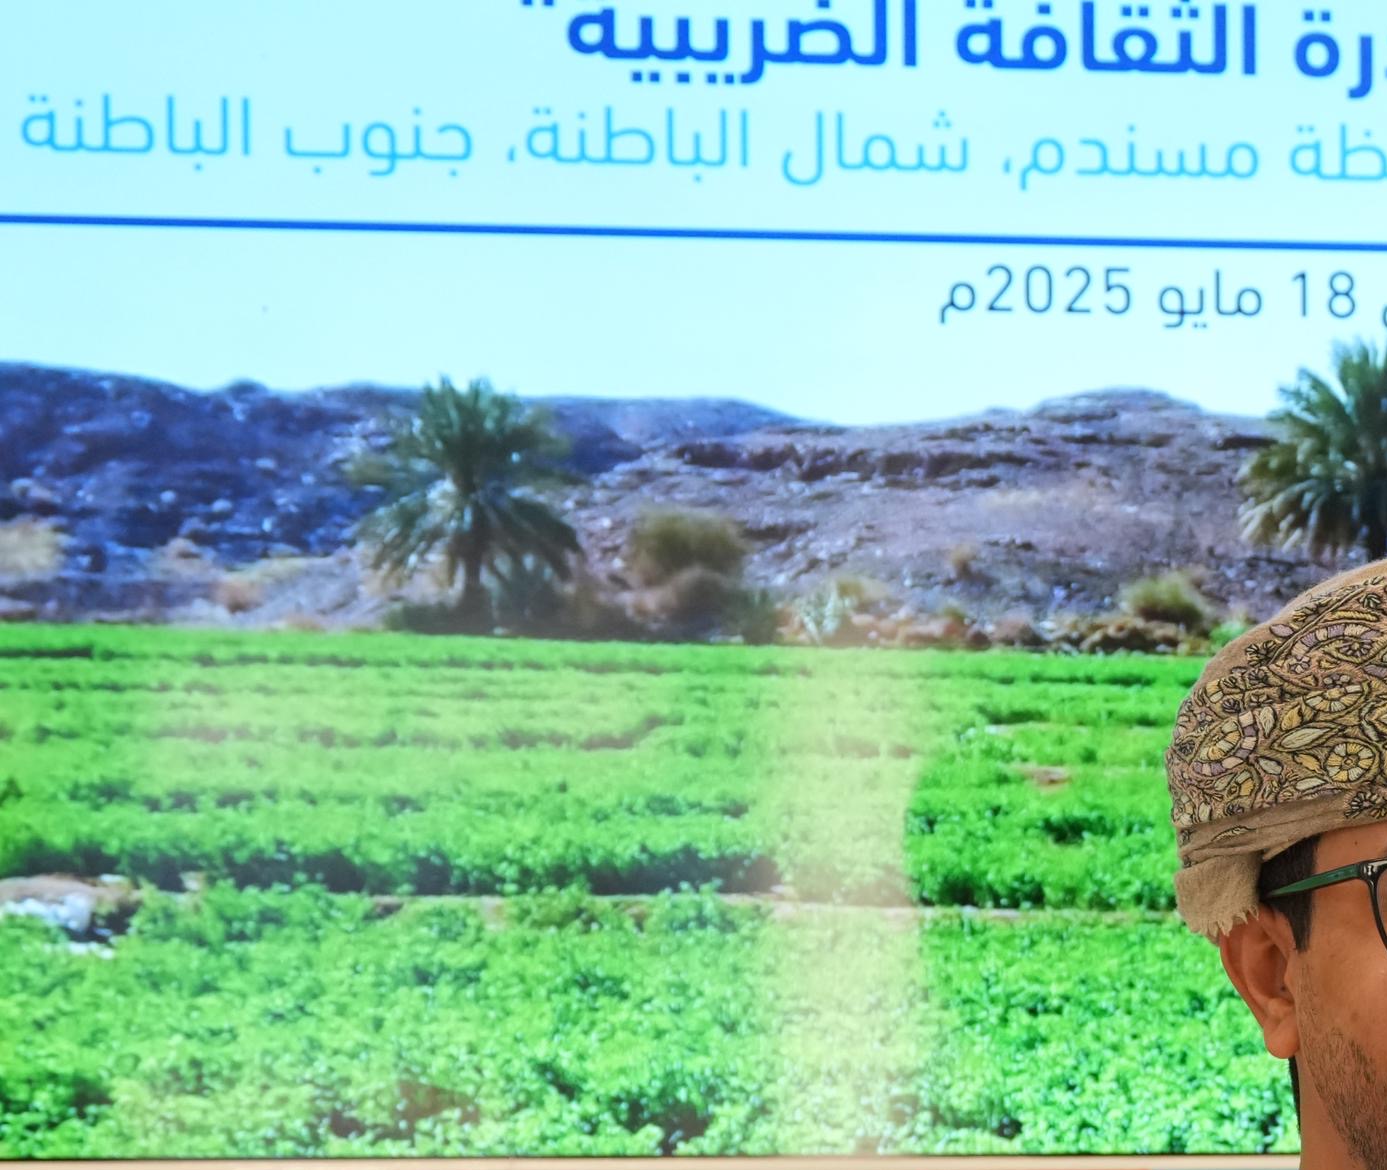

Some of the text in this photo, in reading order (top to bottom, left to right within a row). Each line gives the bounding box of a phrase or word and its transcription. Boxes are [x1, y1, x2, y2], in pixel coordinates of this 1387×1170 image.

[954, 0, 1258, 77] الثقافة
[20, 93, 251, 171] الباطنة
[284, 107, 474, 178] جنوب
[507, 106, 749, 183] الباطنة،
[781, 110, 969, 187] شمال
[1002, 125, 1260, 192] مسندم،
[1158, 269, 1264, 330] مايو
[1292, 270, 1357, 320] 18
